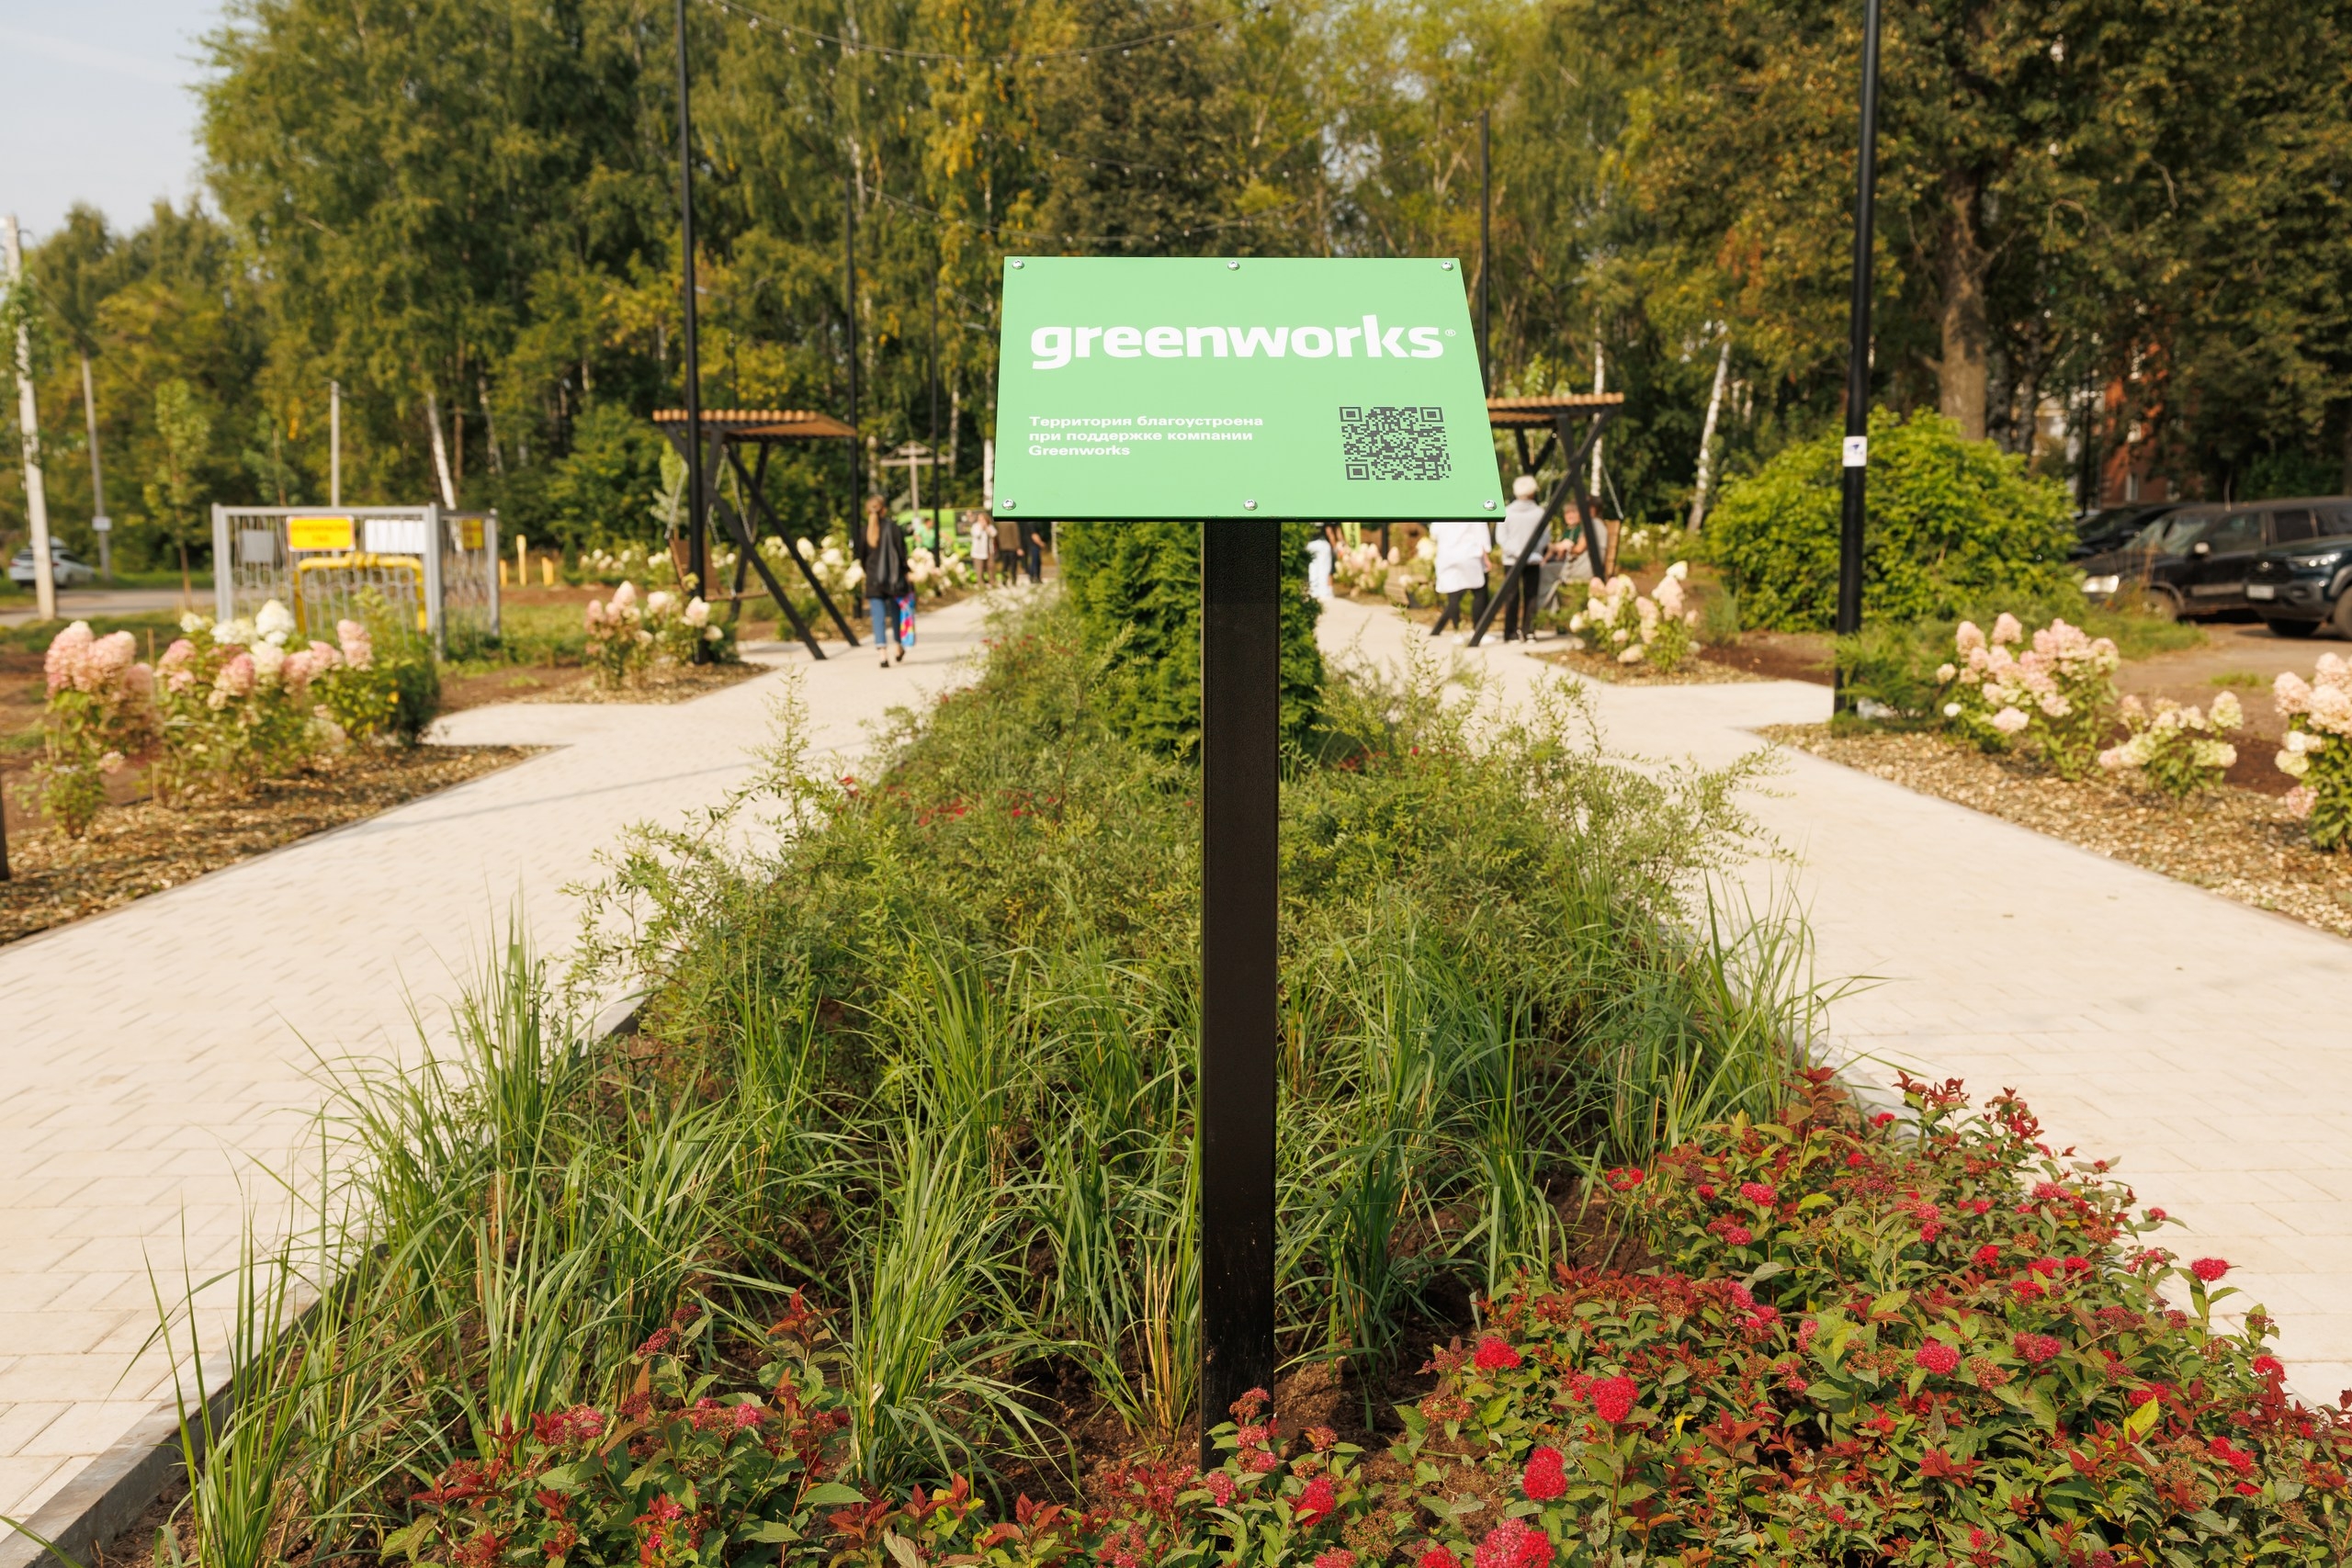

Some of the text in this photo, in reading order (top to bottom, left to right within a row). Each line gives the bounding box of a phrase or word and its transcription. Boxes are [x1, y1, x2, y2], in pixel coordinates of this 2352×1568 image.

[1029, 415, 1263, 428] Территория благоустроена
[1029, 431, 1253, 443] при поддержке компании
[1028, 445, 1131, 456] Greenworks
